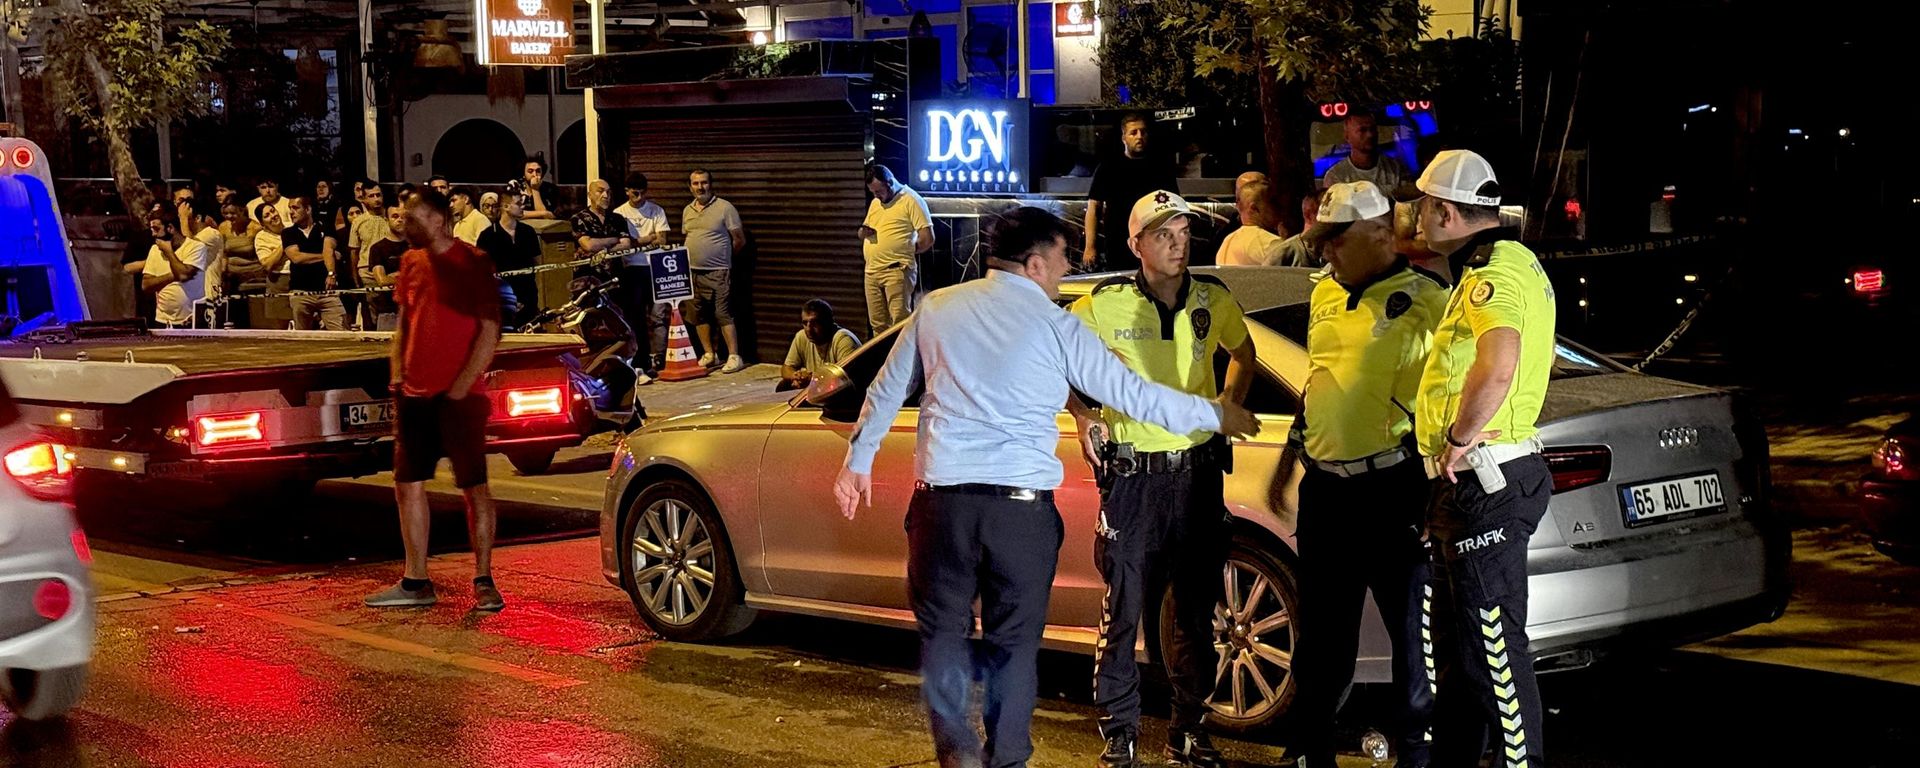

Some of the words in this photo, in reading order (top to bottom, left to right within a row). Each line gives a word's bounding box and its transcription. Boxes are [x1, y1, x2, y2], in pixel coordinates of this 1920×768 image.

[492, 20, 569, 37] MARWELL
[511, 42, 552, 55] BAKERY
[927, 109, 1008, 163] DGN
[920, 170, 1018, 183] GALLERIA
[931, 183, 1025, 192] GALLERIA
[655, 274, 688, 283] COLDWELL
[660, 282, 685, 290] BANKER
[351, 405, 368, 423] 34
[1633, 488, 1655, 516] 65
[1662, 483, 1690, 511] ADL
[1694, 478, 1721, 505] 702
